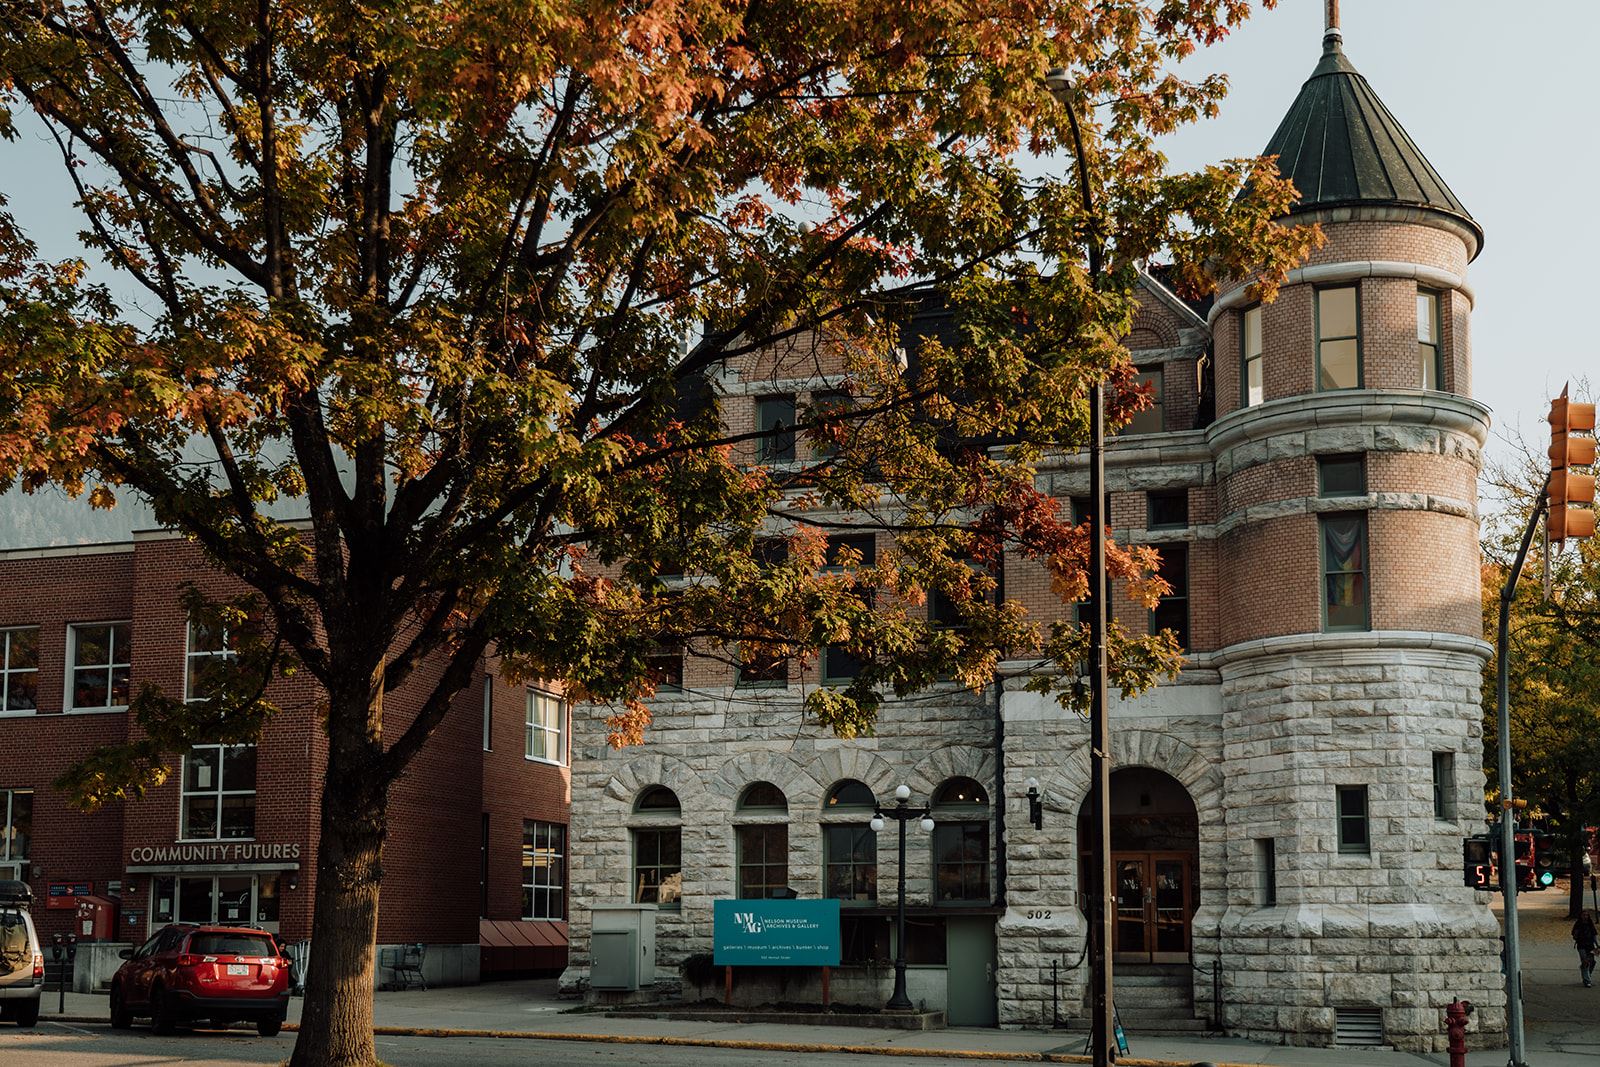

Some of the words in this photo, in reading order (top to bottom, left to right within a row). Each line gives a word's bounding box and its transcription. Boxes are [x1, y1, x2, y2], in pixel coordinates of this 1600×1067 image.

[131, 845, 230, 862] COMMUNITY
[234, 843, 300, 860] FUTURES
[1476, 865, 1485, 884] 5
[1027, 910, 1052, 920] 502
